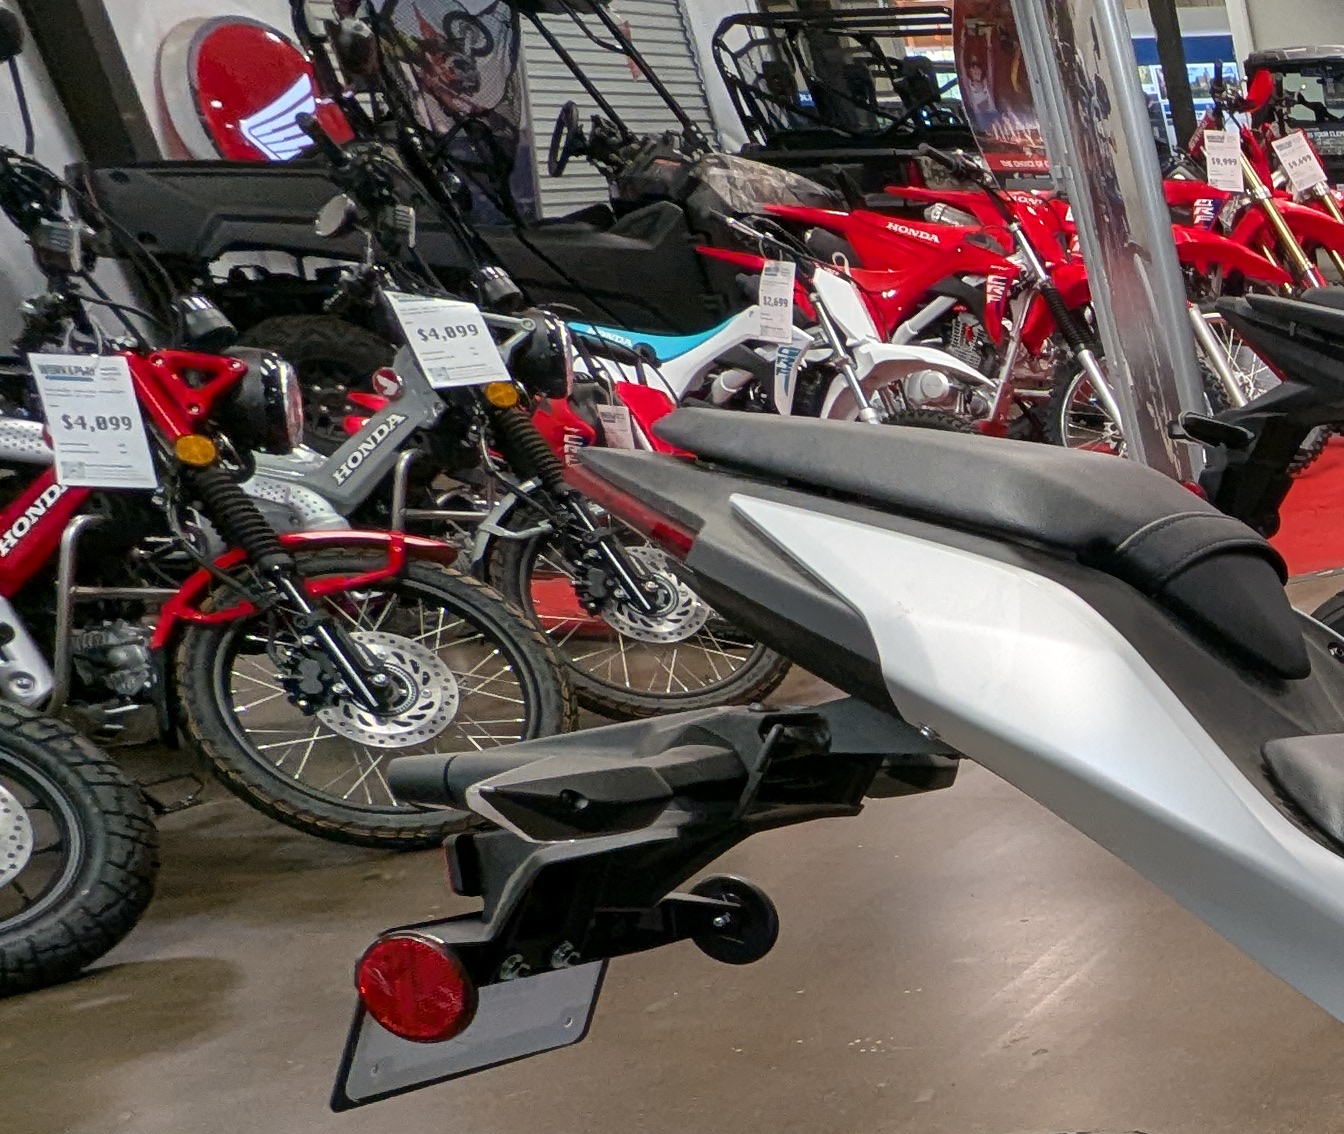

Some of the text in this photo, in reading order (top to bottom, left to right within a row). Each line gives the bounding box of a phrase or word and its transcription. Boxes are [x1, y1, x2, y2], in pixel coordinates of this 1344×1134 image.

[885, 221, 940, 244] HONDA
[762, 296, 789, 308] $2,699
[332, 412, 408, 486] HONDA
